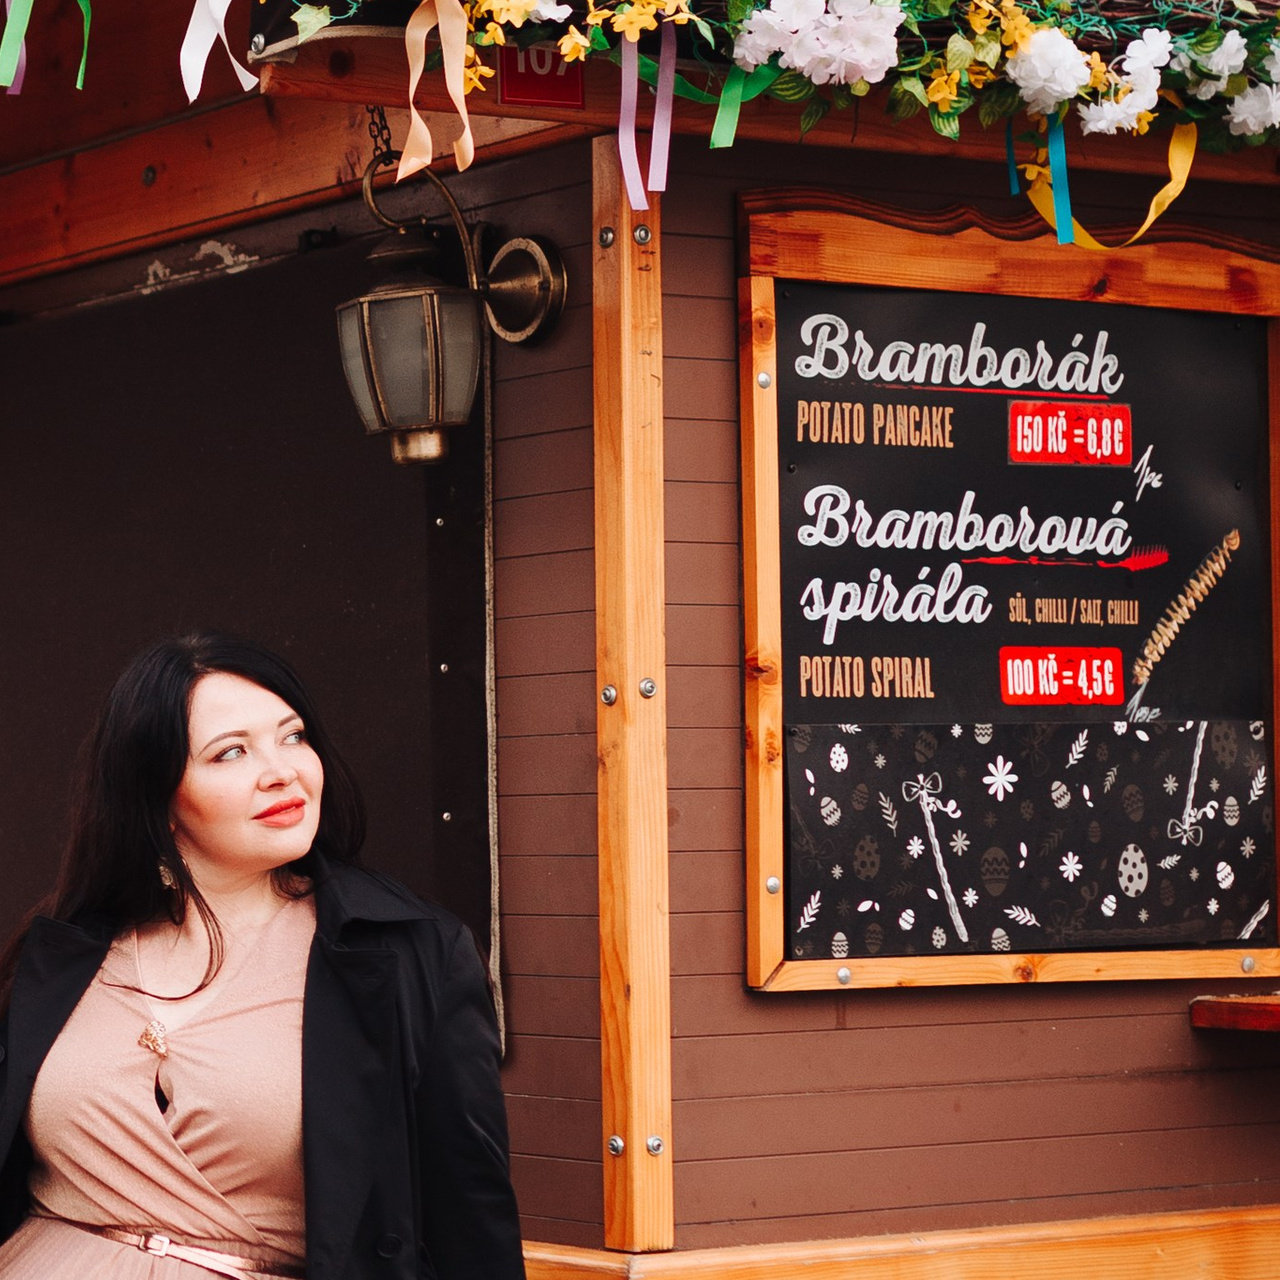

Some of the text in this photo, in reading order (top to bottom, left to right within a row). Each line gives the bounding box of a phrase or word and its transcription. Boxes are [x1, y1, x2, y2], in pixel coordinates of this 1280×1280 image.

[794, 313, 1125, 394] Bramborák
[797, 400, 954, 448] POTATO PANCAKE
[1016, 415, 1043, 453] 150
[1047, 410, 1067, 453] KČ
[797, 484, 1132, 555] Bramborová
[799, 562, 993, 646] spirála
[1035, 598, 1067, 624] CHILLI
[1080, 599, 1104, 627] SALT,
[1107, 600, 1139, 625] CHILLI
[799, 656, 935, 699] POTATO SPIRAL
[1007, 659, 1034, 696] 100
[1038, 653, 1059, 696] KČ
